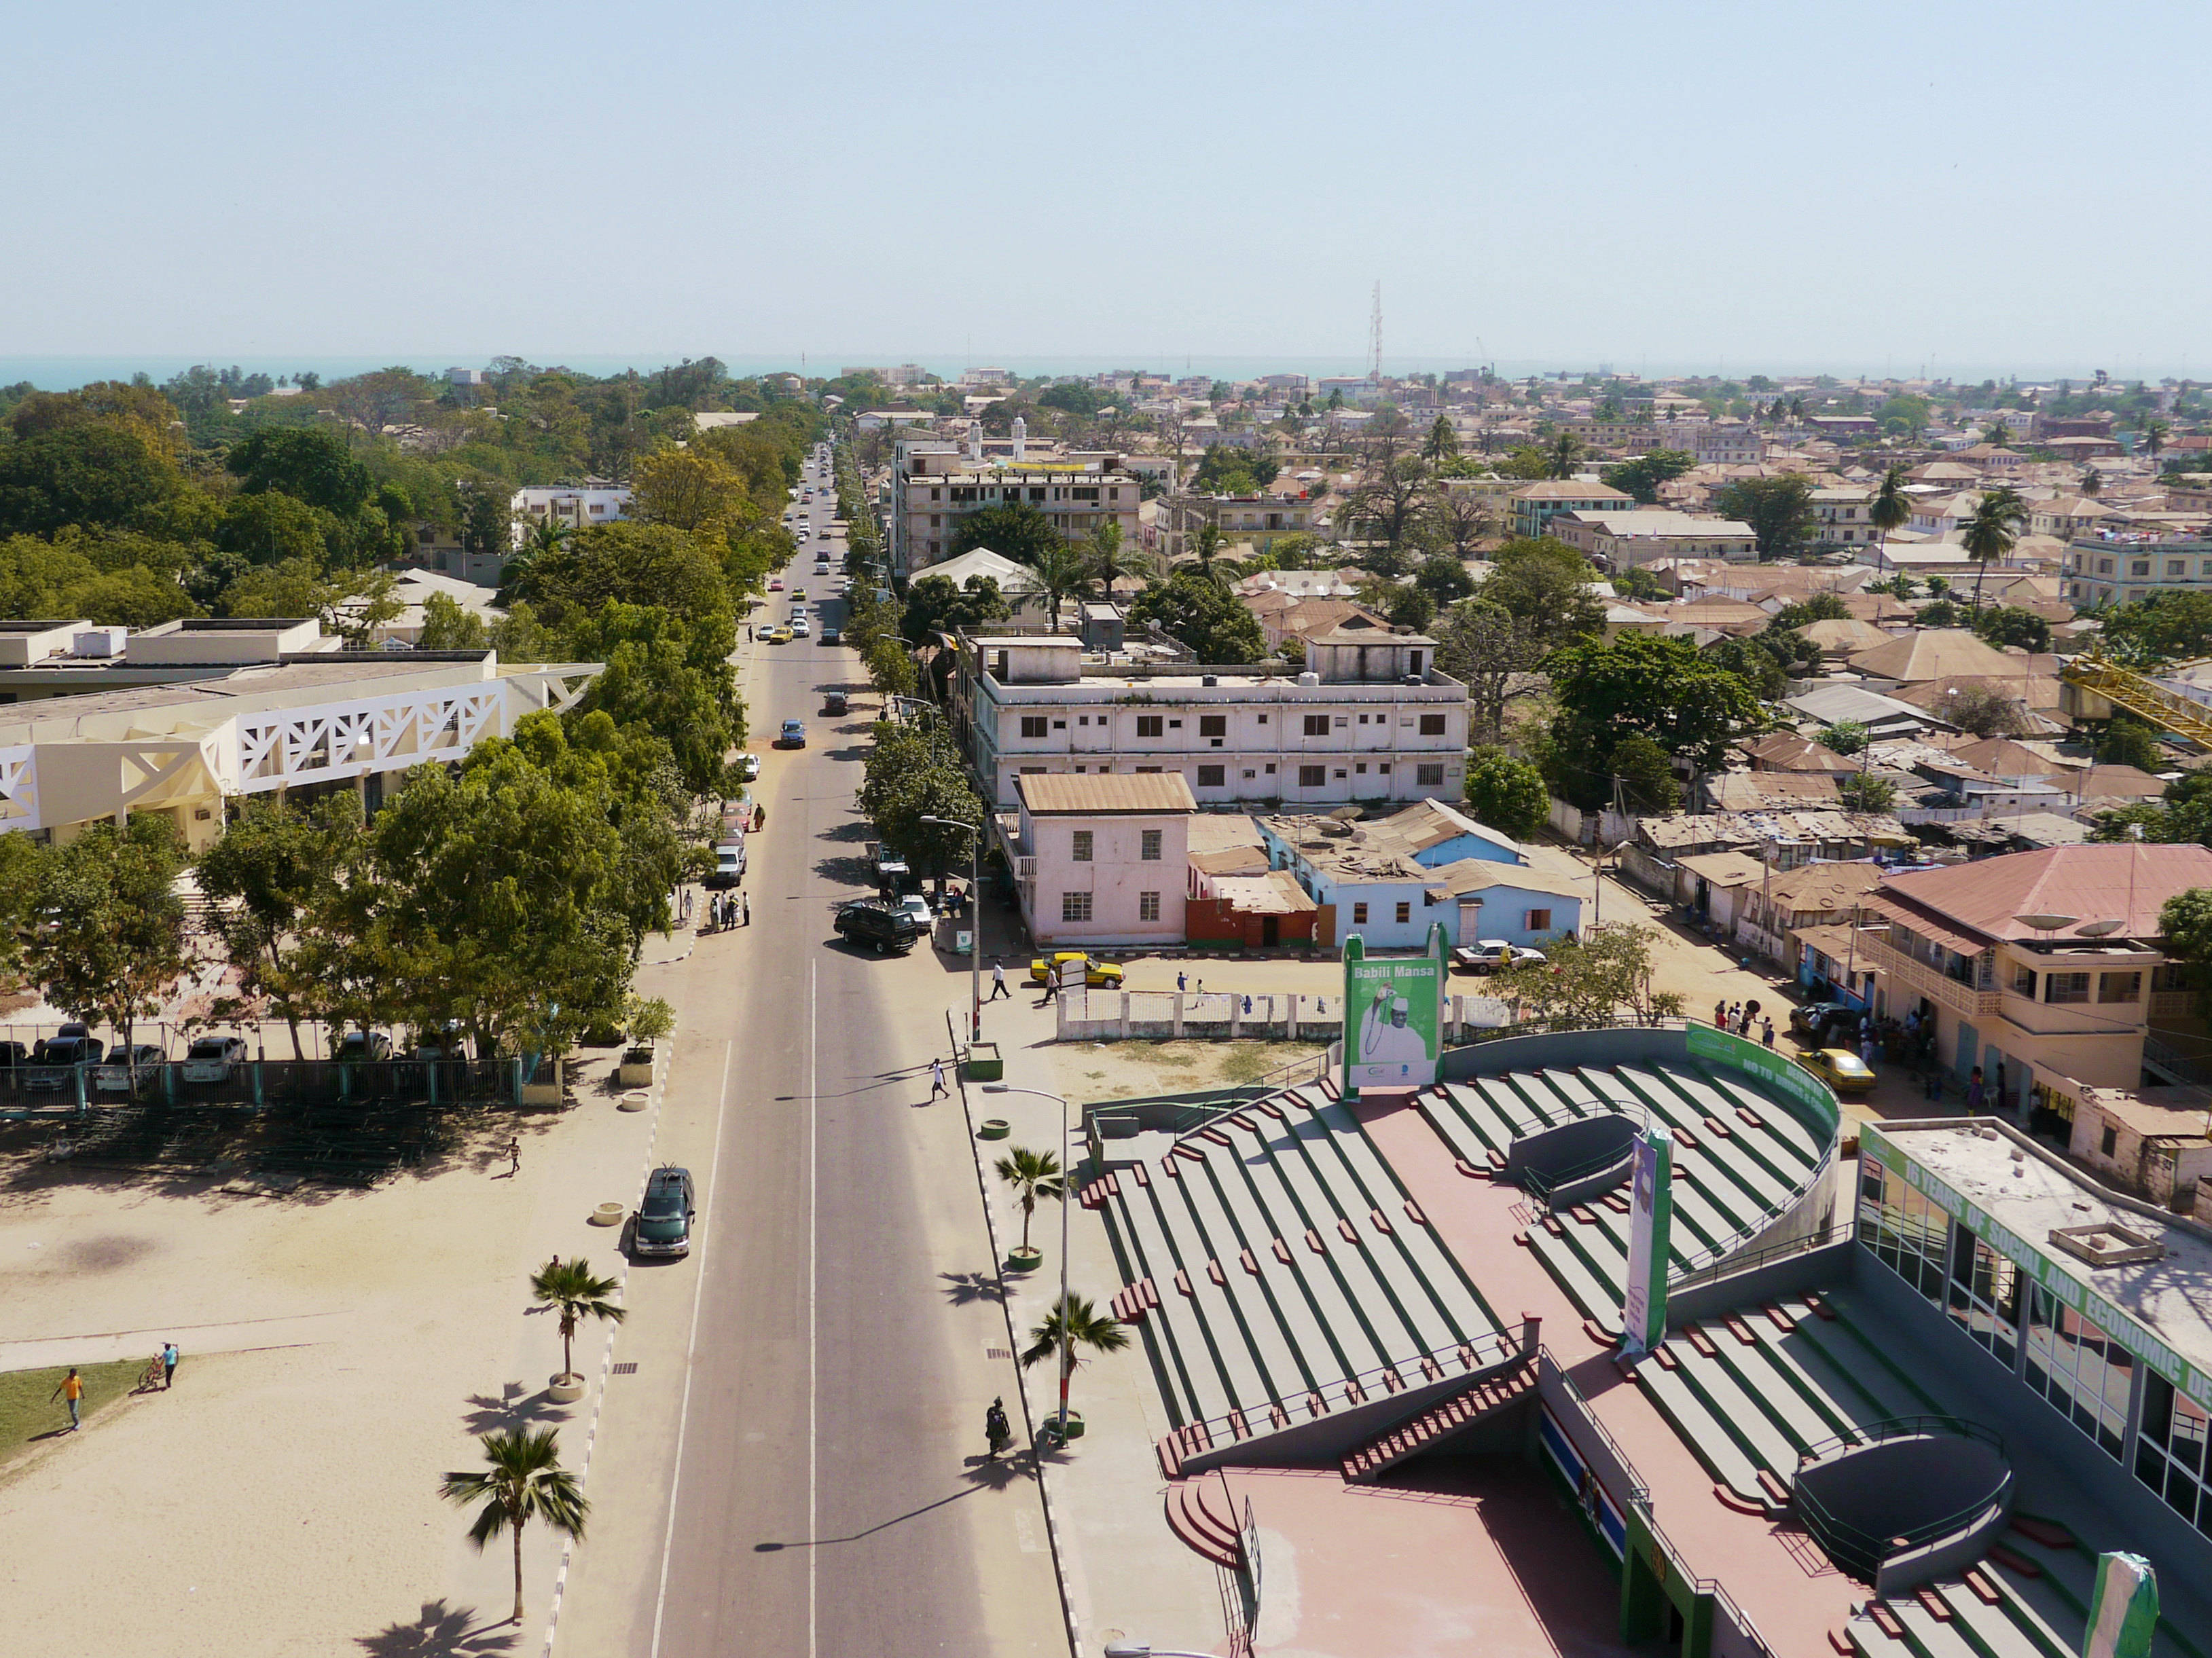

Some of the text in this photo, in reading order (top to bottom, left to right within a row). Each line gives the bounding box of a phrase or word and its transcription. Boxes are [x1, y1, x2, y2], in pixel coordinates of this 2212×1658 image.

[1354, 965, 1434, 978] Babili Mansa
[1743, 1058, 1758, 1073] NO
[1760, 1065, 1772, 1080] TO
[1906, 1160, 1919, 1186] 16
[1922, 1169, 1963, 1217] YEARS
[1967, 1204, 1986, 1232] OF
[1989, 1219, 2040, 1277] SOCIAL
[2045, 1264, 2080, 1307] AND
[2086, 1291, 2181, 1382] ECONOMIC
